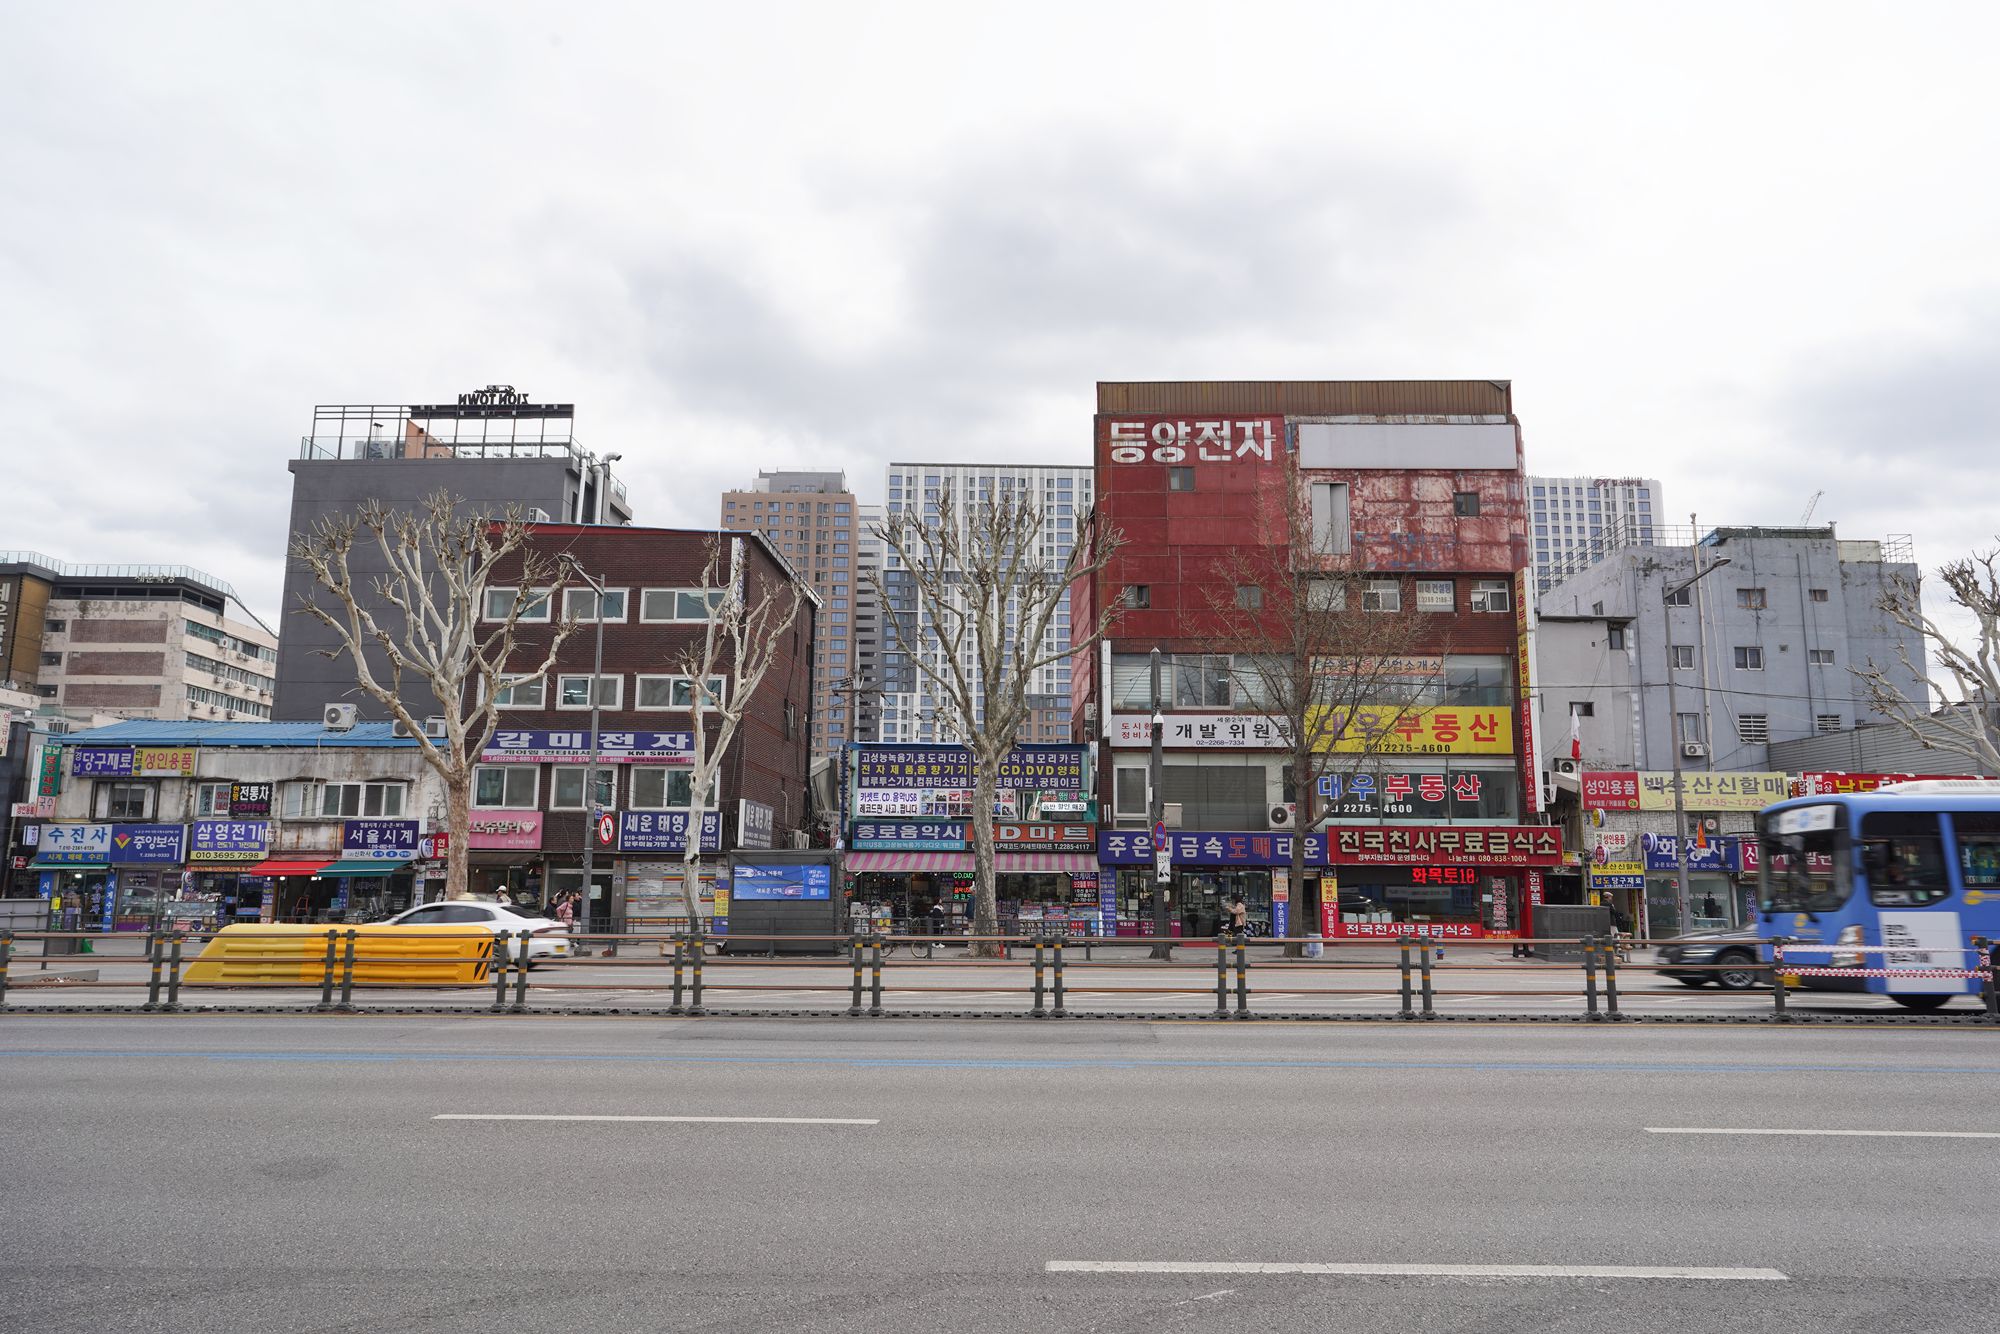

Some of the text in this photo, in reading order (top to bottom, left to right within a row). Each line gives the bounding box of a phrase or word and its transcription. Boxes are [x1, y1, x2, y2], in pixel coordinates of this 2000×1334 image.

[82, 752, 131, 771] 당구재료
[145, 752, 192, 770] 성인용품
[240, 785, 269, 801] 전통차
[1586, 780, 1636, 796] 성인용품
[197, 823, 262, 841] 삼영전기
[626, 814, 653, 833] 세운
[658, 814, 685, 833] 태영
[857, 824, 962, 839] 종로음악사
[48, 826, 108, 844] 수진사
[350, 829, 413, 844] 서울시계
[1339, 830, 1558, 854] 전국천사무료급식소
[133, 835, 179, 860] 중앙보석
[1478, 855, 1528, 863] 080-838-1004
[1346, 923, 1473, 936] 전국천사무료급식소
